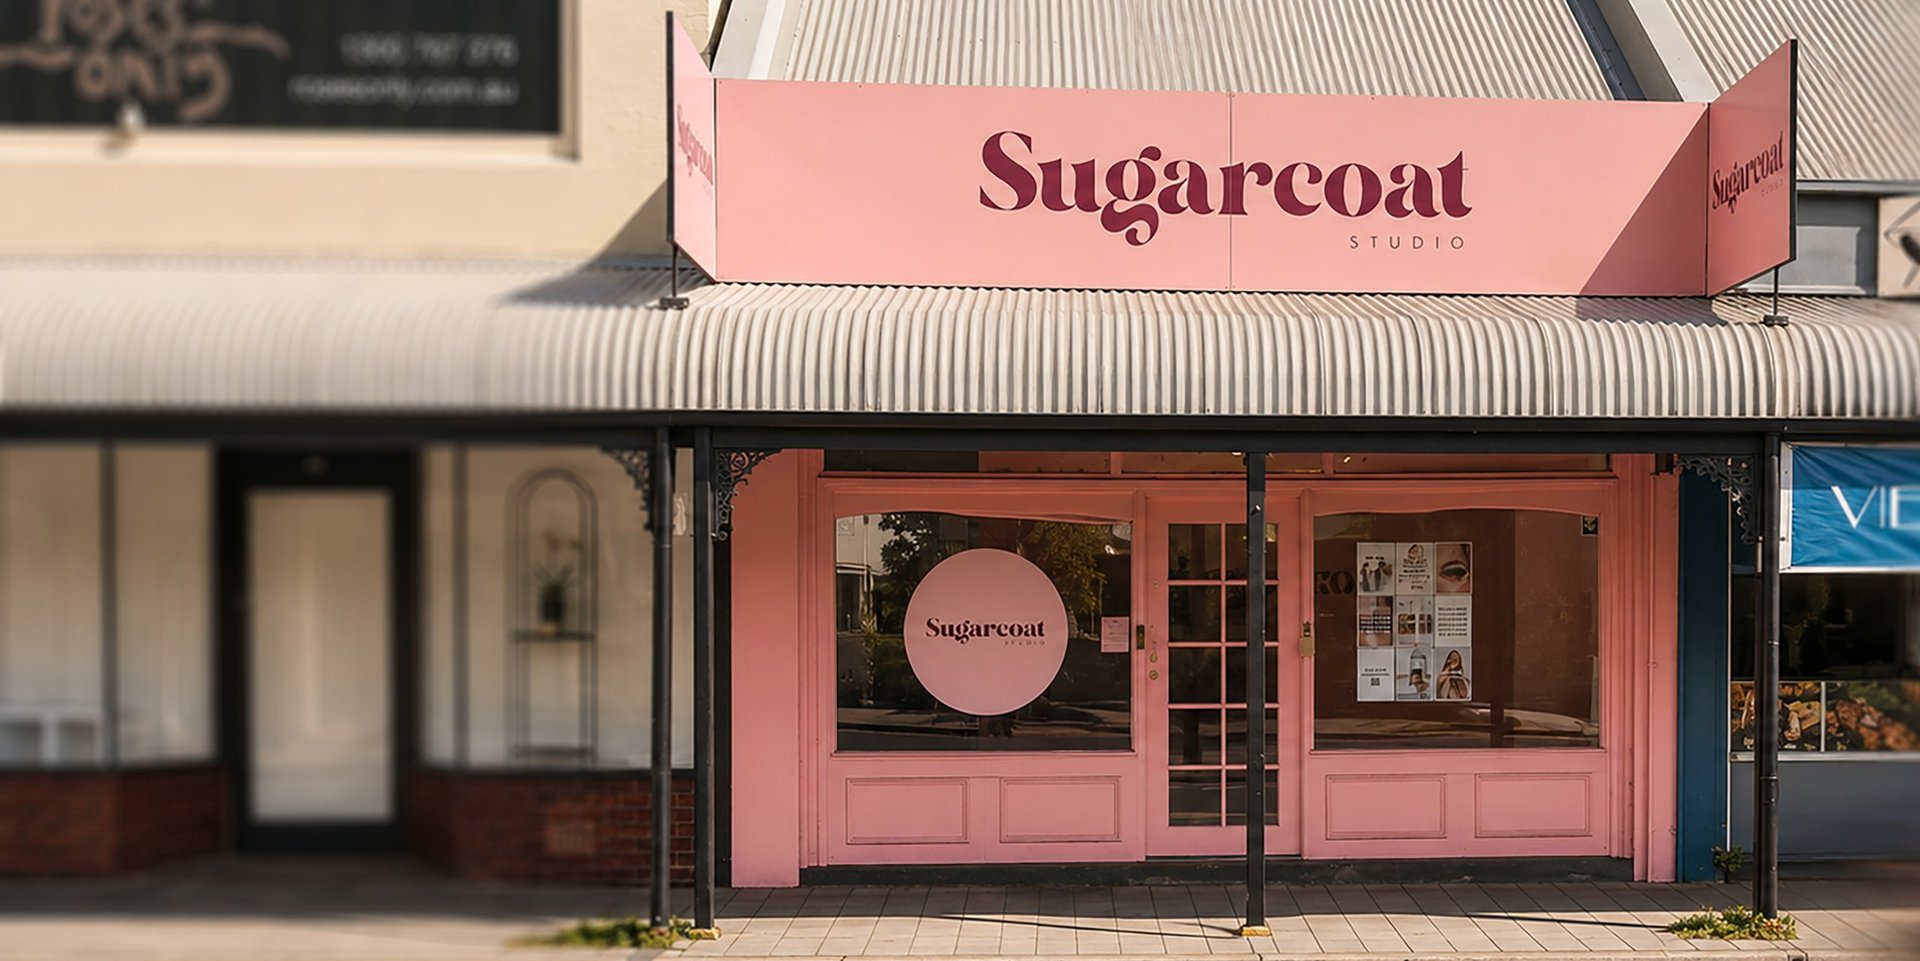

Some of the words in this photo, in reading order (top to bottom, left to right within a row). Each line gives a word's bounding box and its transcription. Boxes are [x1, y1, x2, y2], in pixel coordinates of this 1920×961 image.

[979, 130, 1473, 246] Sugarcoat
[1712, 130, 1784, 214] Sugarcoat
[1350, 235, 1464, 250] STUDIO
[925, 617, 1045, 644] Sugarcoat
